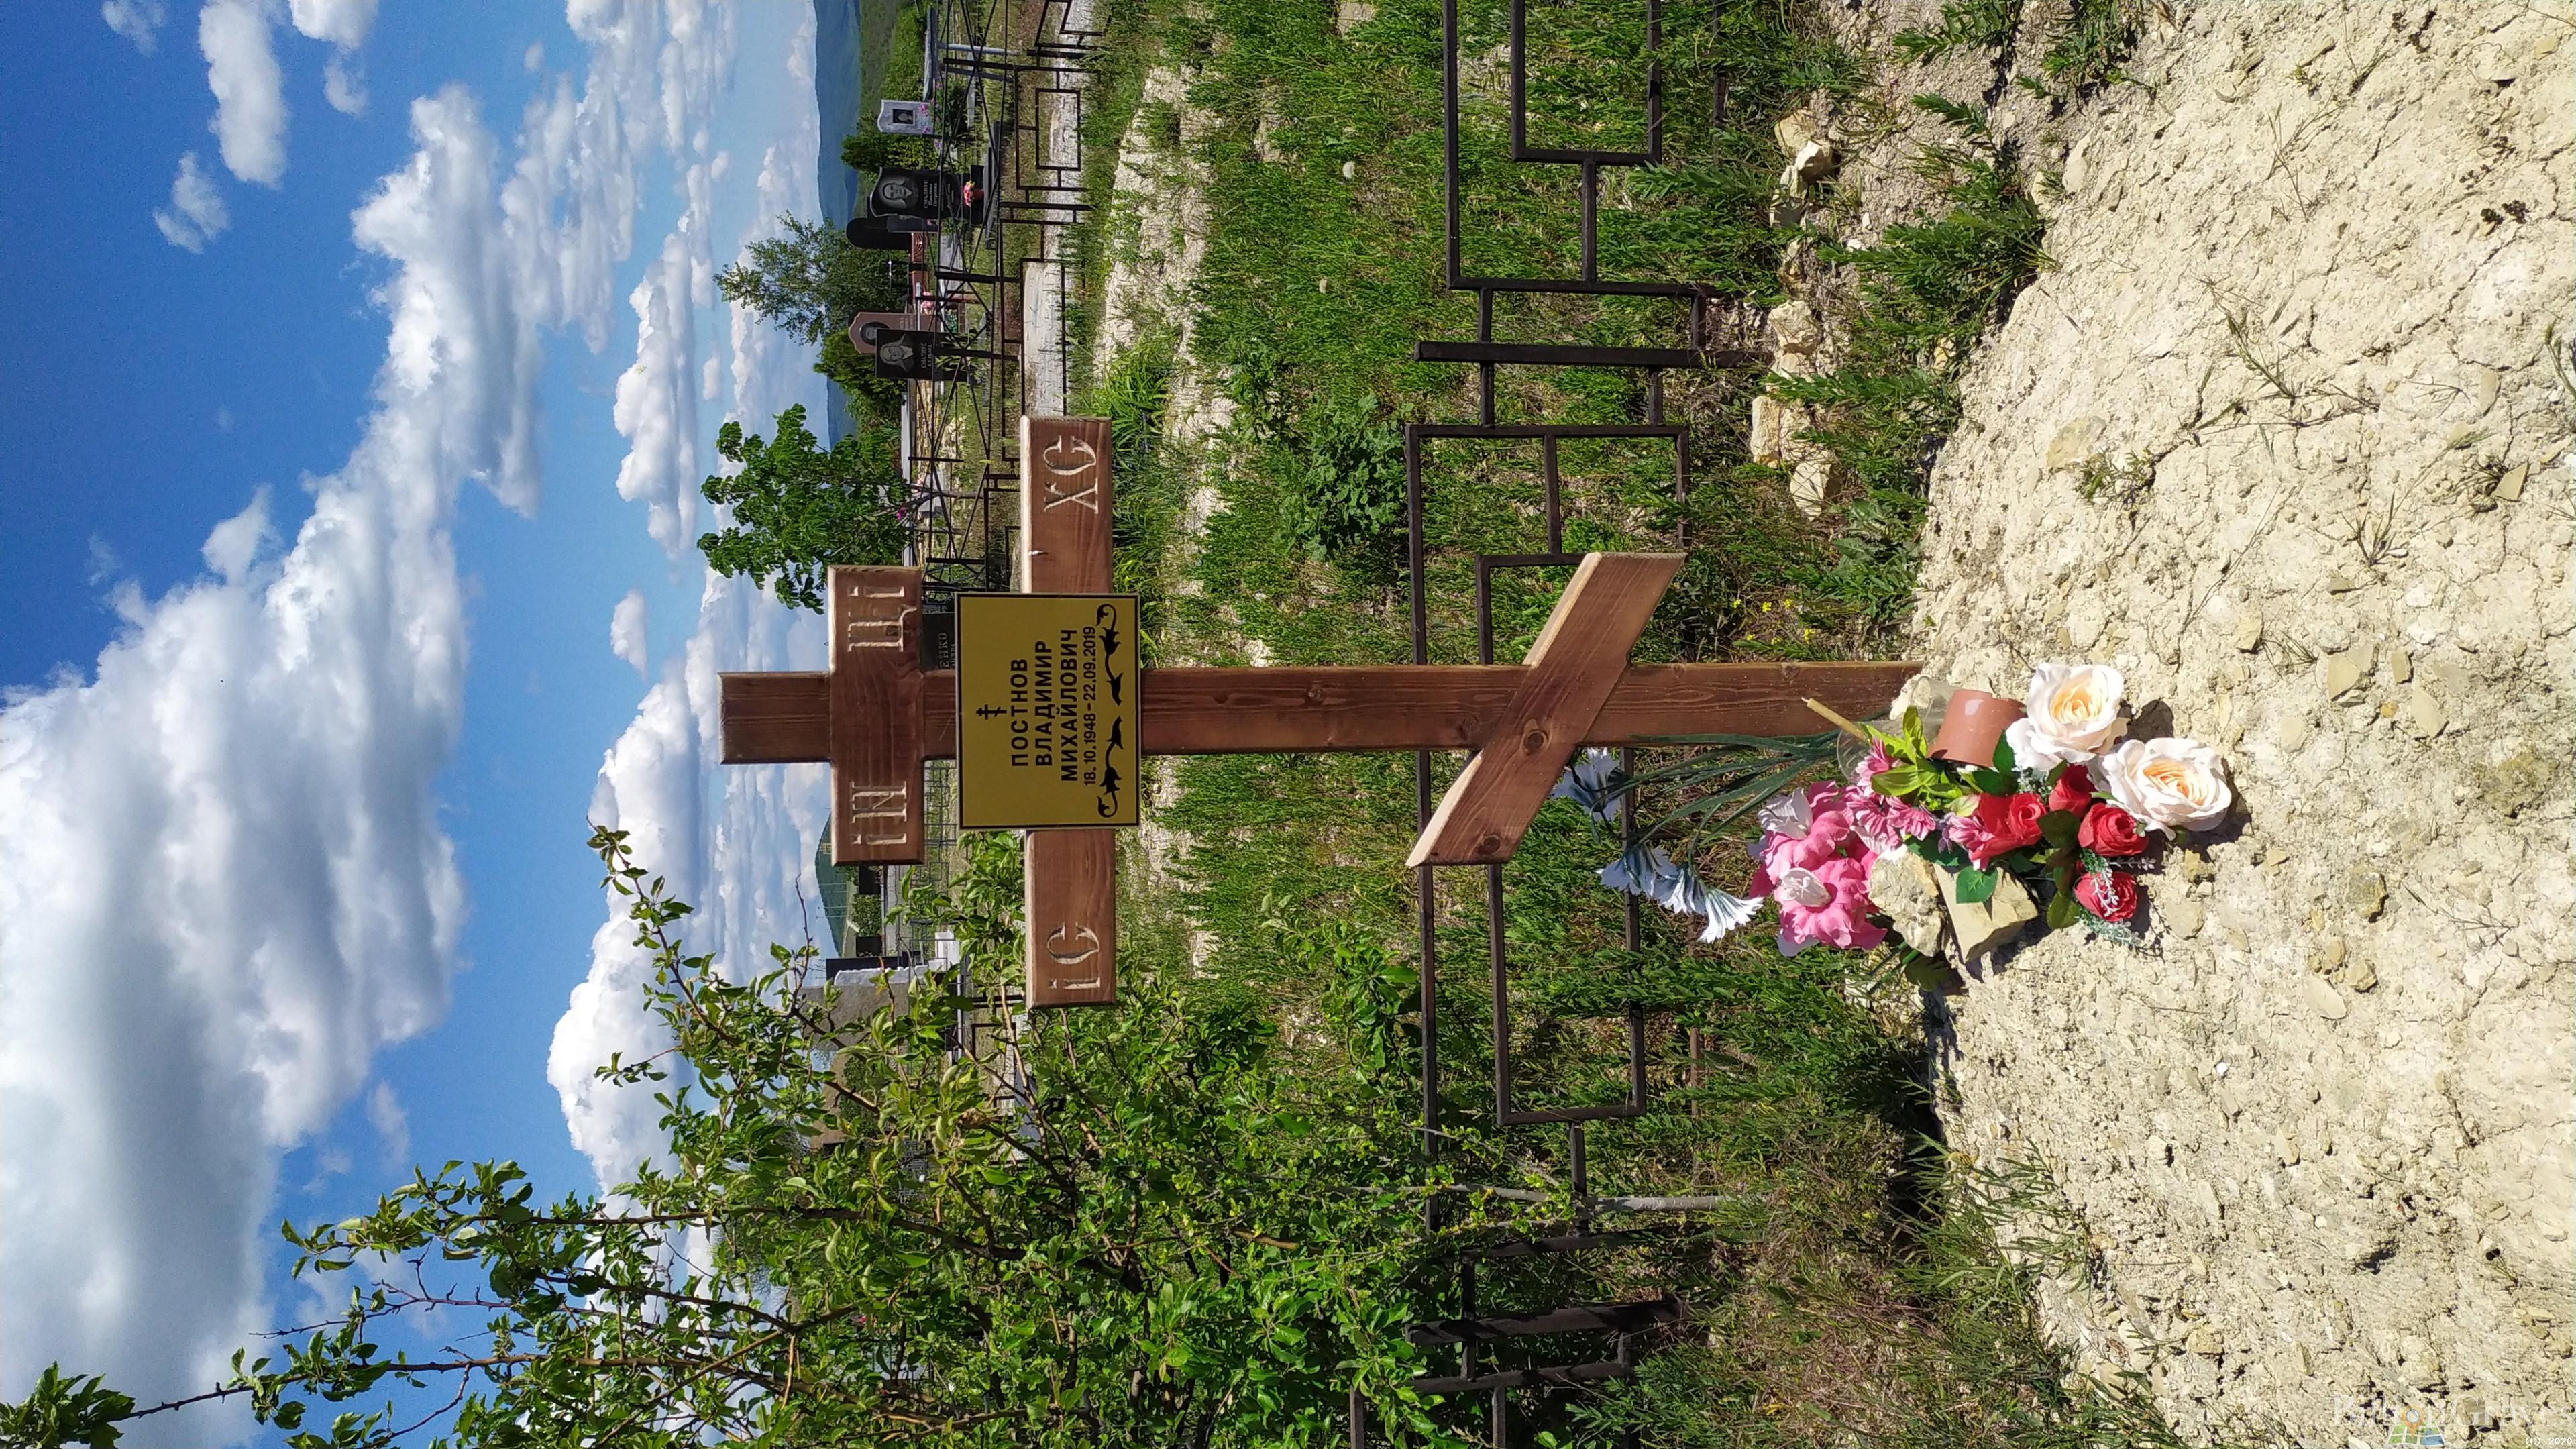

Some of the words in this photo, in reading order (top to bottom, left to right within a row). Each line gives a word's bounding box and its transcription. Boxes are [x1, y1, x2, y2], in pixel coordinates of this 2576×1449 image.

[1010, 659, 1028, 766] ПОСТНОВ
[1035, 641, 1055, 766] ВЛАДИМИР
[1056, 629, 1077, 782] МИХАЙЛОВИЧ
